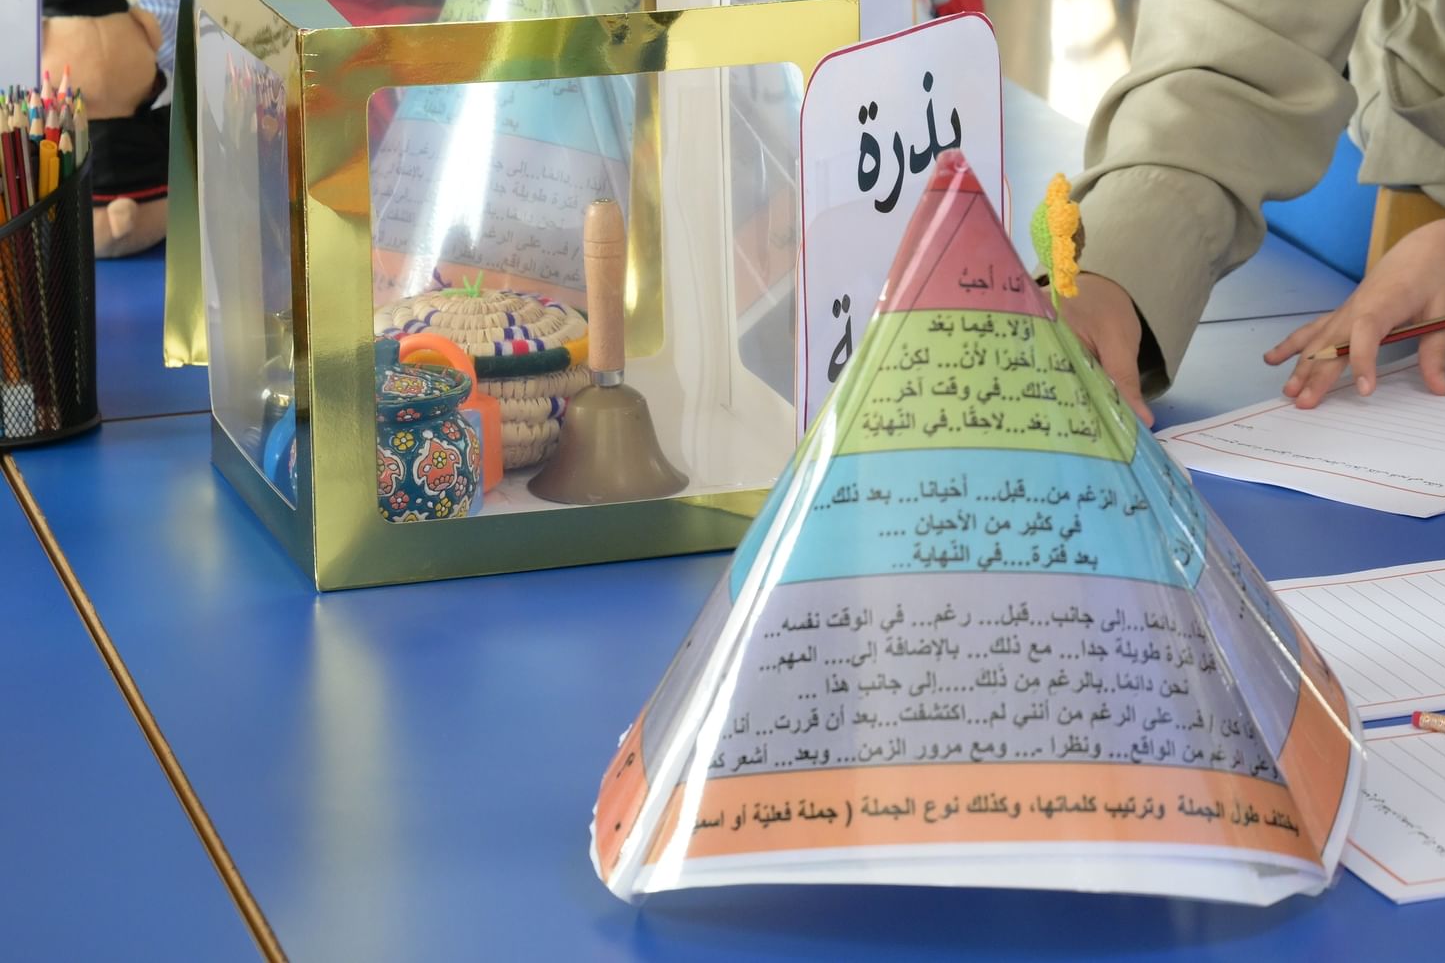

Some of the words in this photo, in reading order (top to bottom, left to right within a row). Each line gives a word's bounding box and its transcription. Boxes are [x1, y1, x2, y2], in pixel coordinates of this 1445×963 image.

[931, 379, 970, 400] وقت
[984, 516, 1011, 535] من
[1018, 512, 1053, 535] كثير
[1059, 514, 1082, 539] في
[1073, 548, 1098, 571] بعد
[826, 607, 872, 631] الوقت
[881, 603, 904, 632] في
[1028, 642, 1052, 663] مع
[1115, 639, 1160, 665] طويلة
[826, 674, 849, 694] هذا
[1057, 706, 1083, 725] من
[730, 804, 747, 831] أو
[798, 799, 838, 824] جملة
[860, 795, 915, 820] الجملة
[922, 795, 959, 822] نوع
[966, 792, 1021, 819] وكذلك
[1104, 795, 1167, 821] وترتيب
[1177, 794, 1225, 822] الجملة
[1231, 799, 1260, 825] طول
